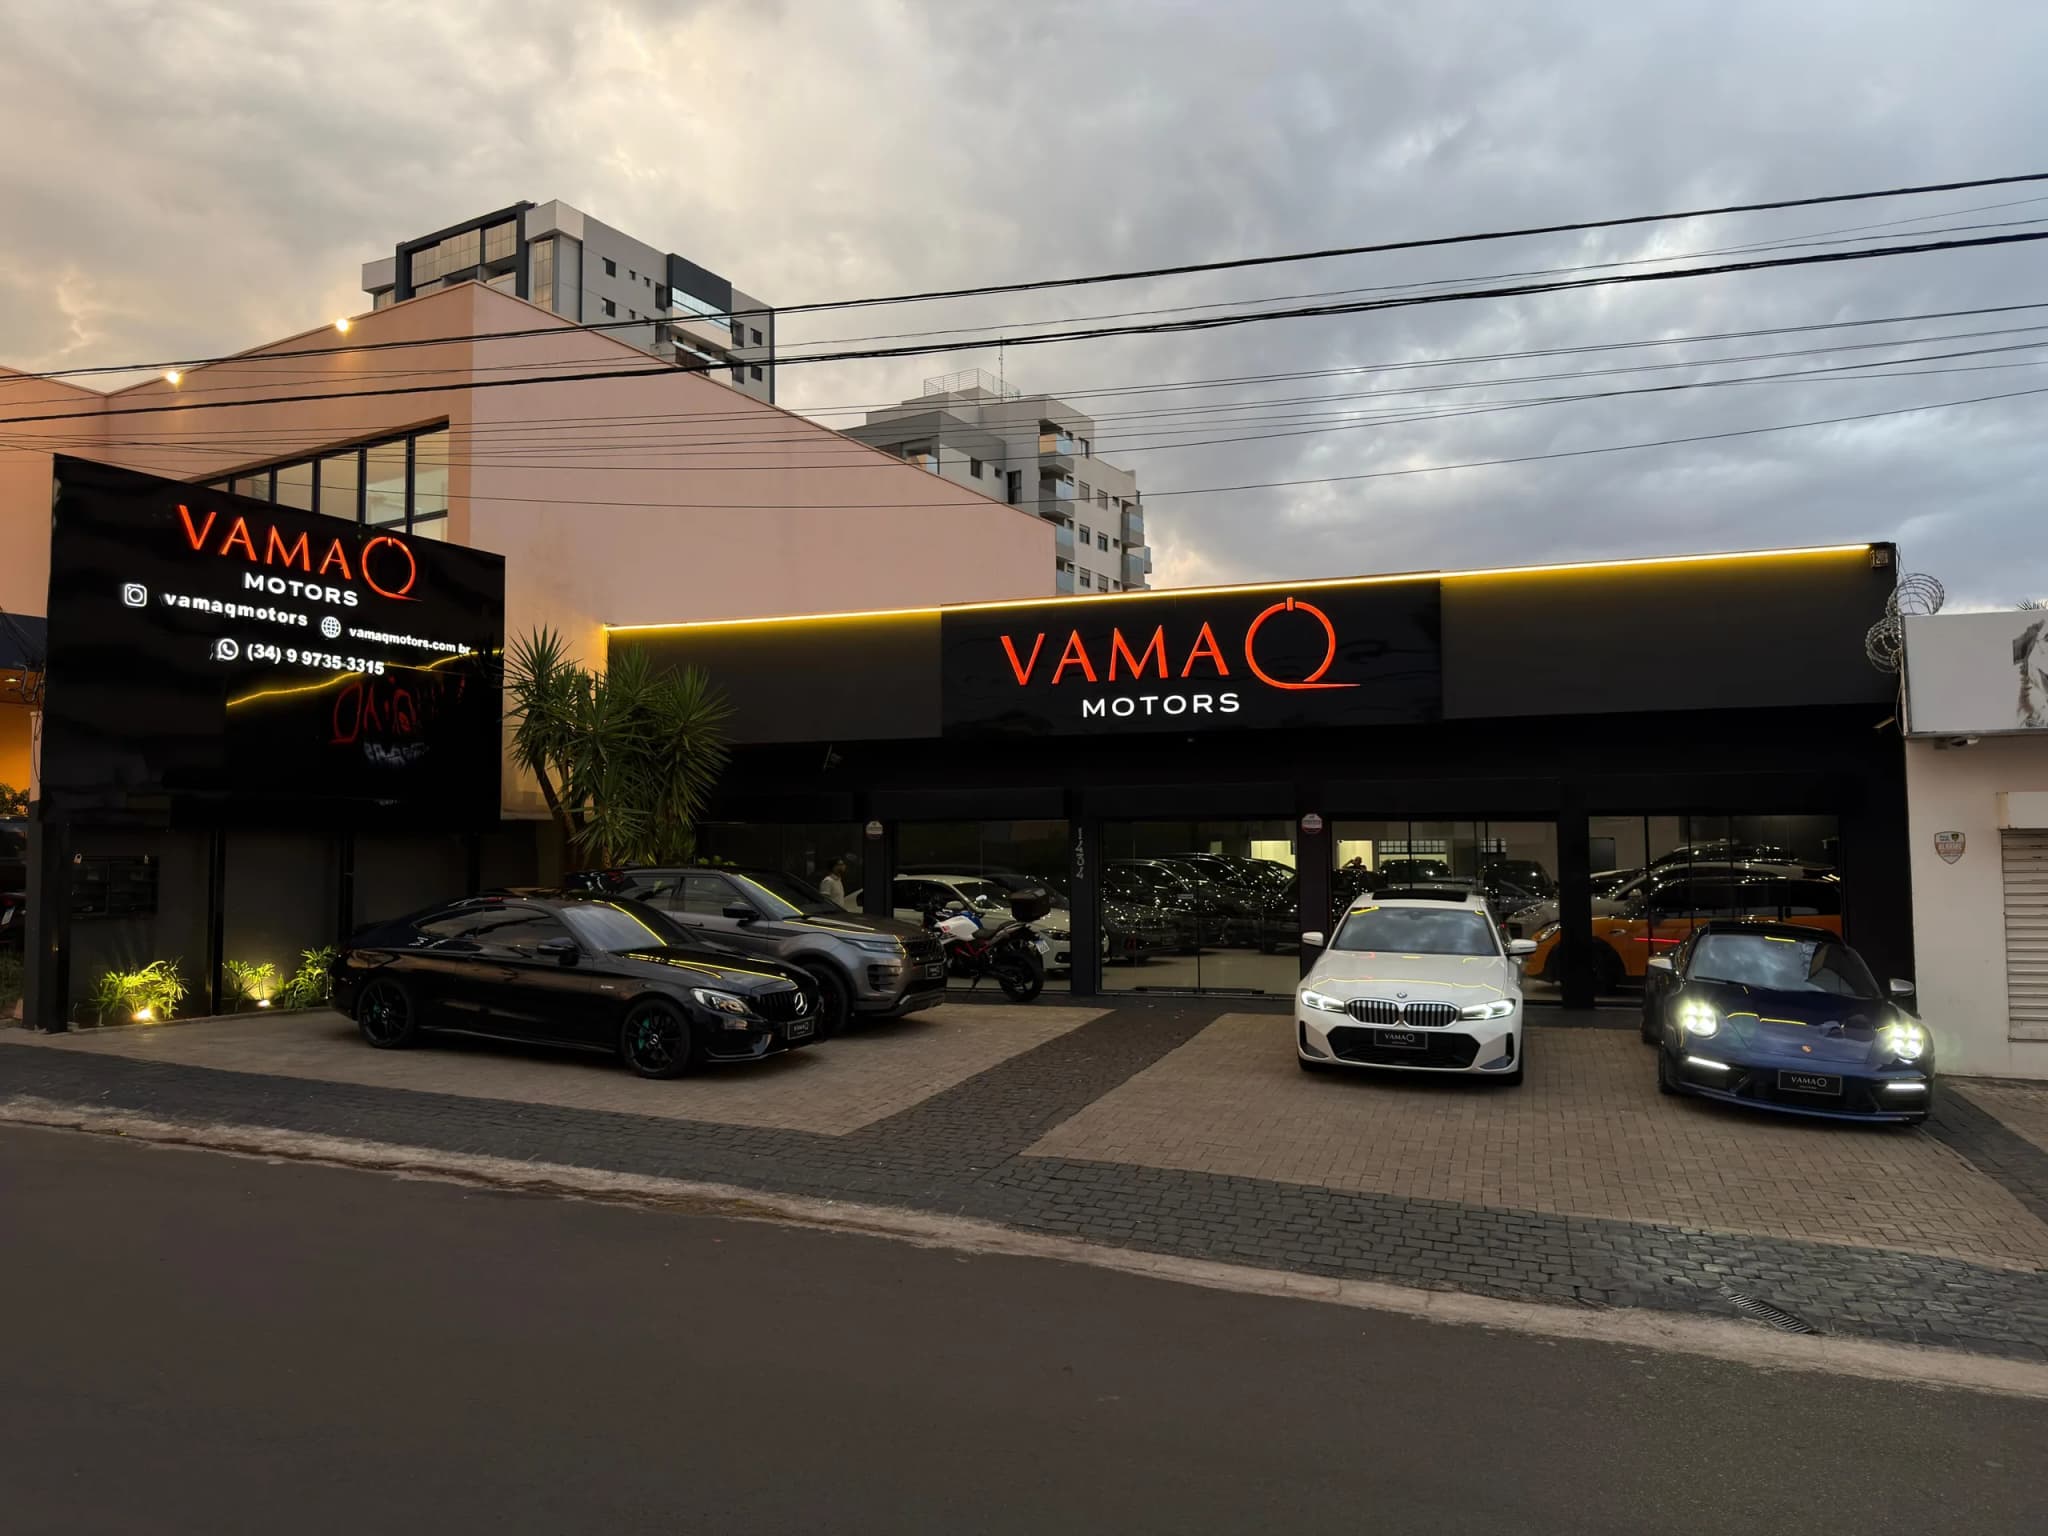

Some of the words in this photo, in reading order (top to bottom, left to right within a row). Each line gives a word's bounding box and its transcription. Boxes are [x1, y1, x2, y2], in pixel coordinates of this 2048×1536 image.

[177, 504, 422, 602] VAMAQ
[244, 572, 359, 607] MOTORS
[164, 592, 308, 627] vamaqmotors
[247, 643, 282, 664] (34)
[286, 649, 297, 663] 9
[301, 650, 385, 676] 9735-3315
[1000, 596, 1361, 690] VAMAQ
[1082, 693, 1240, 718] MOTORS
